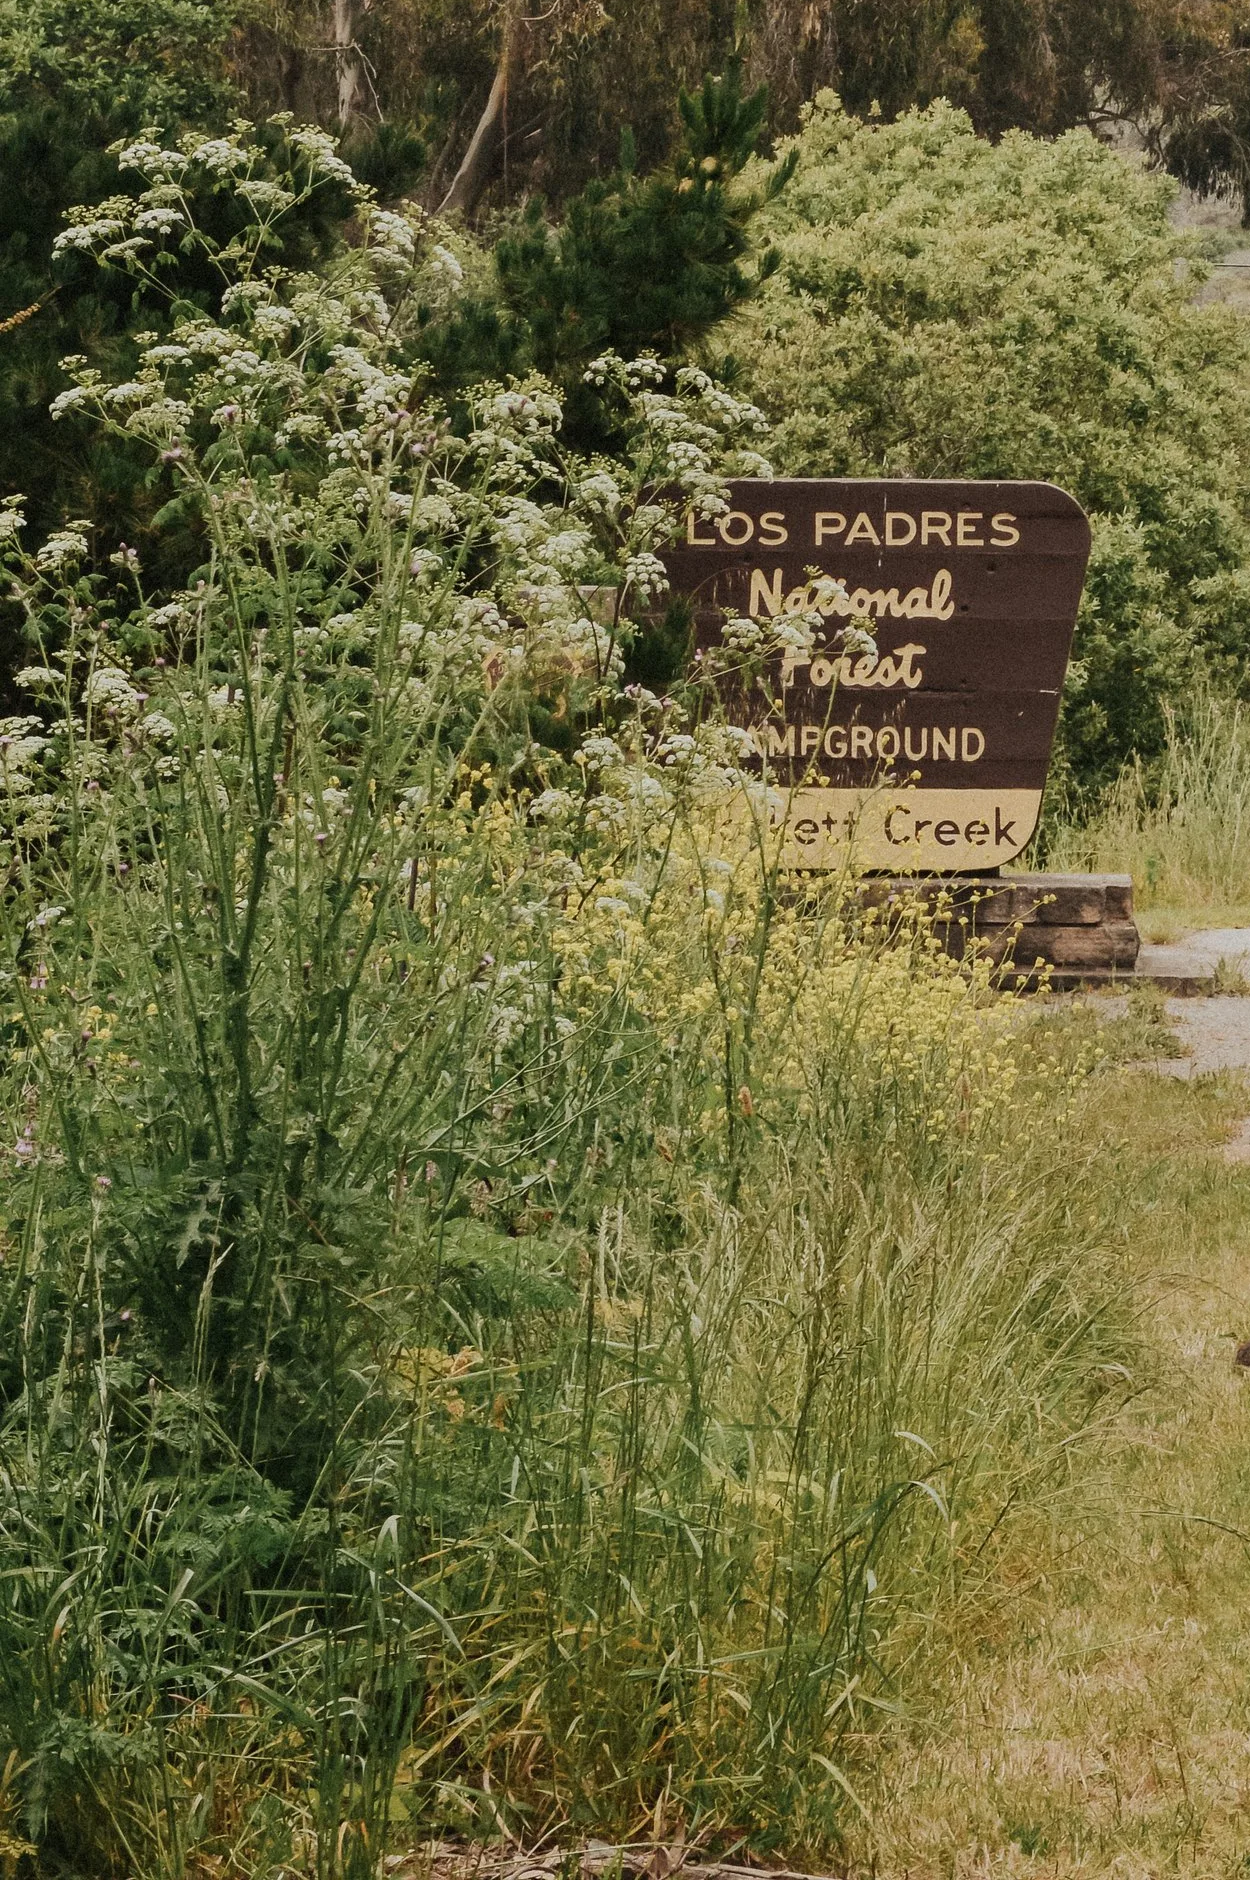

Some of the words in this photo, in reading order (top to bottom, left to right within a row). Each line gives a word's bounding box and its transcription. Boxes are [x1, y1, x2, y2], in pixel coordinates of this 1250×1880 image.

[687, 512, 788, 546] LOS
[815, 512, 1020, 546] PADRES
[749, 568, 955, 620] National
[782, 642, 926, 688] Forest
[746, 725, 985, 762] AMPGROUND
[884, 805, 1017, 846] Creek
